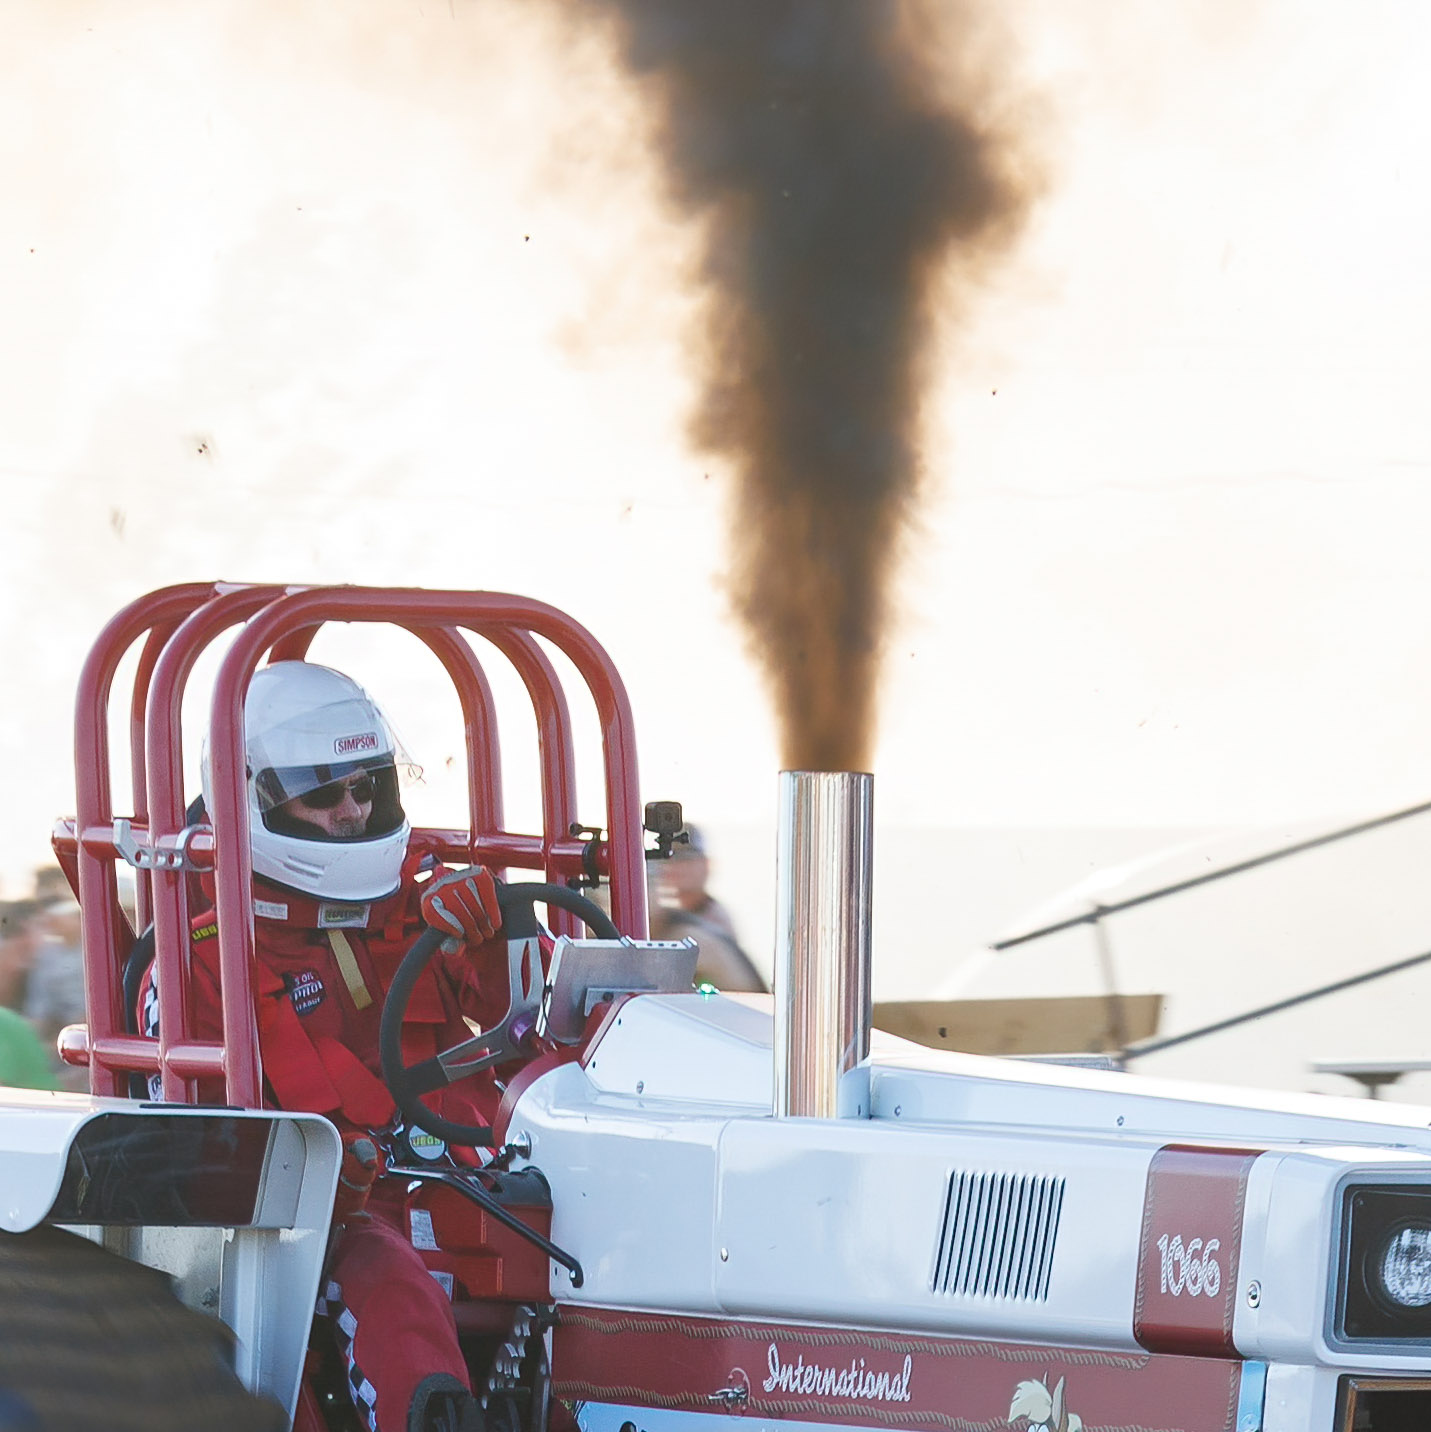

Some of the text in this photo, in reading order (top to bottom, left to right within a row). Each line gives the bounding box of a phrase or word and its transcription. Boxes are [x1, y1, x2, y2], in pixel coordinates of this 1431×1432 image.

[337, 735, 376, 753] SIMPSON
[1157, 1233, 1221, 1298] 1066
[763, 1343, 911, 1402] International
